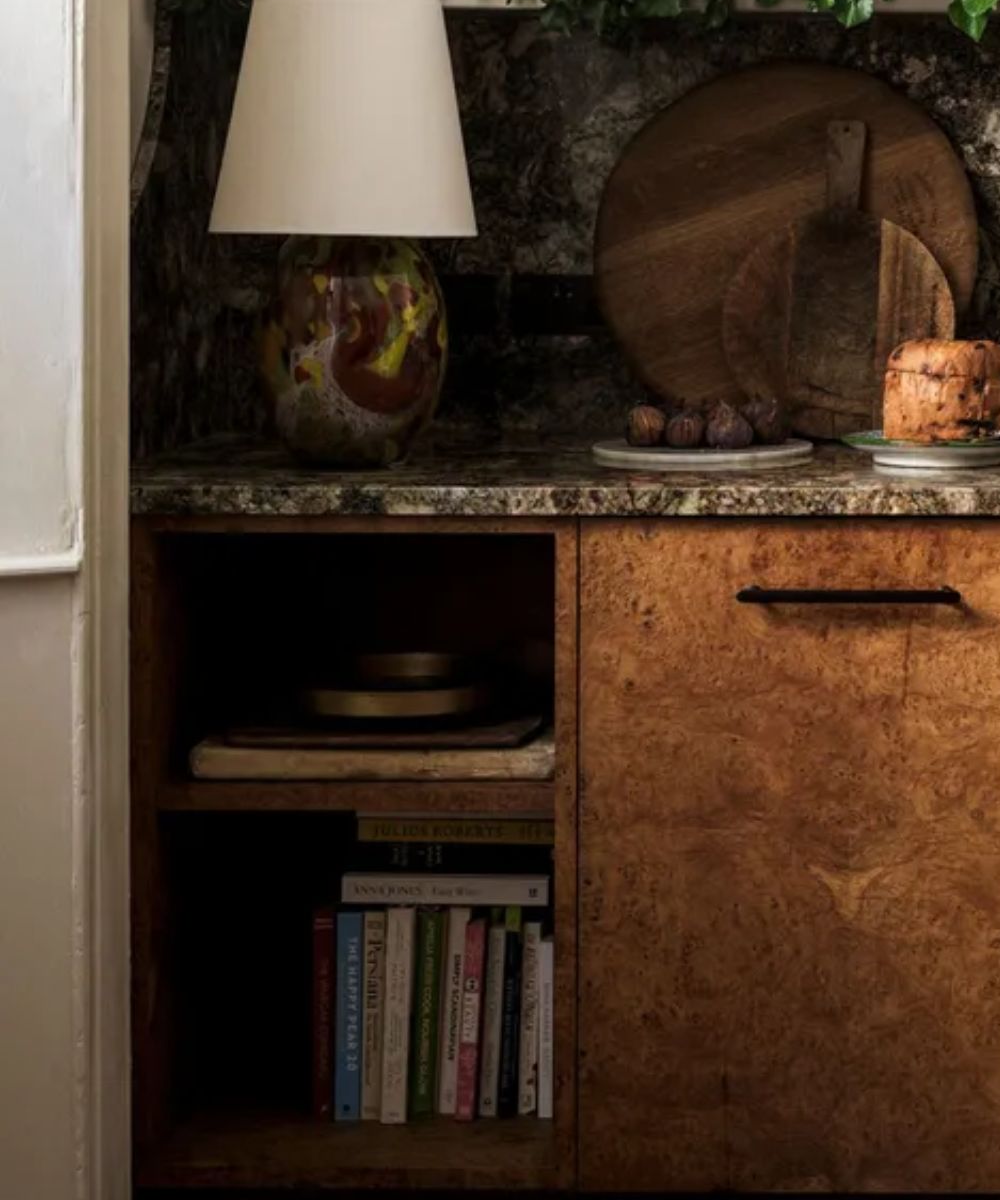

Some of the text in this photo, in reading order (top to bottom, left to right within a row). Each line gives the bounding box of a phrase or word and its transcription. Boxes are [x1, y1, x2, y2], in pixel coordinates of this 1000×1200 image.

[347, 936, 358, 962] THE
[346, 967, 358, 1011] HAPPY
[367, 939, 382, 1010] Persiana
[447, 954, 462, 1061] SIMPLY SCANDINAVIAN
[345, 1015, 357, 1050] PEAR
